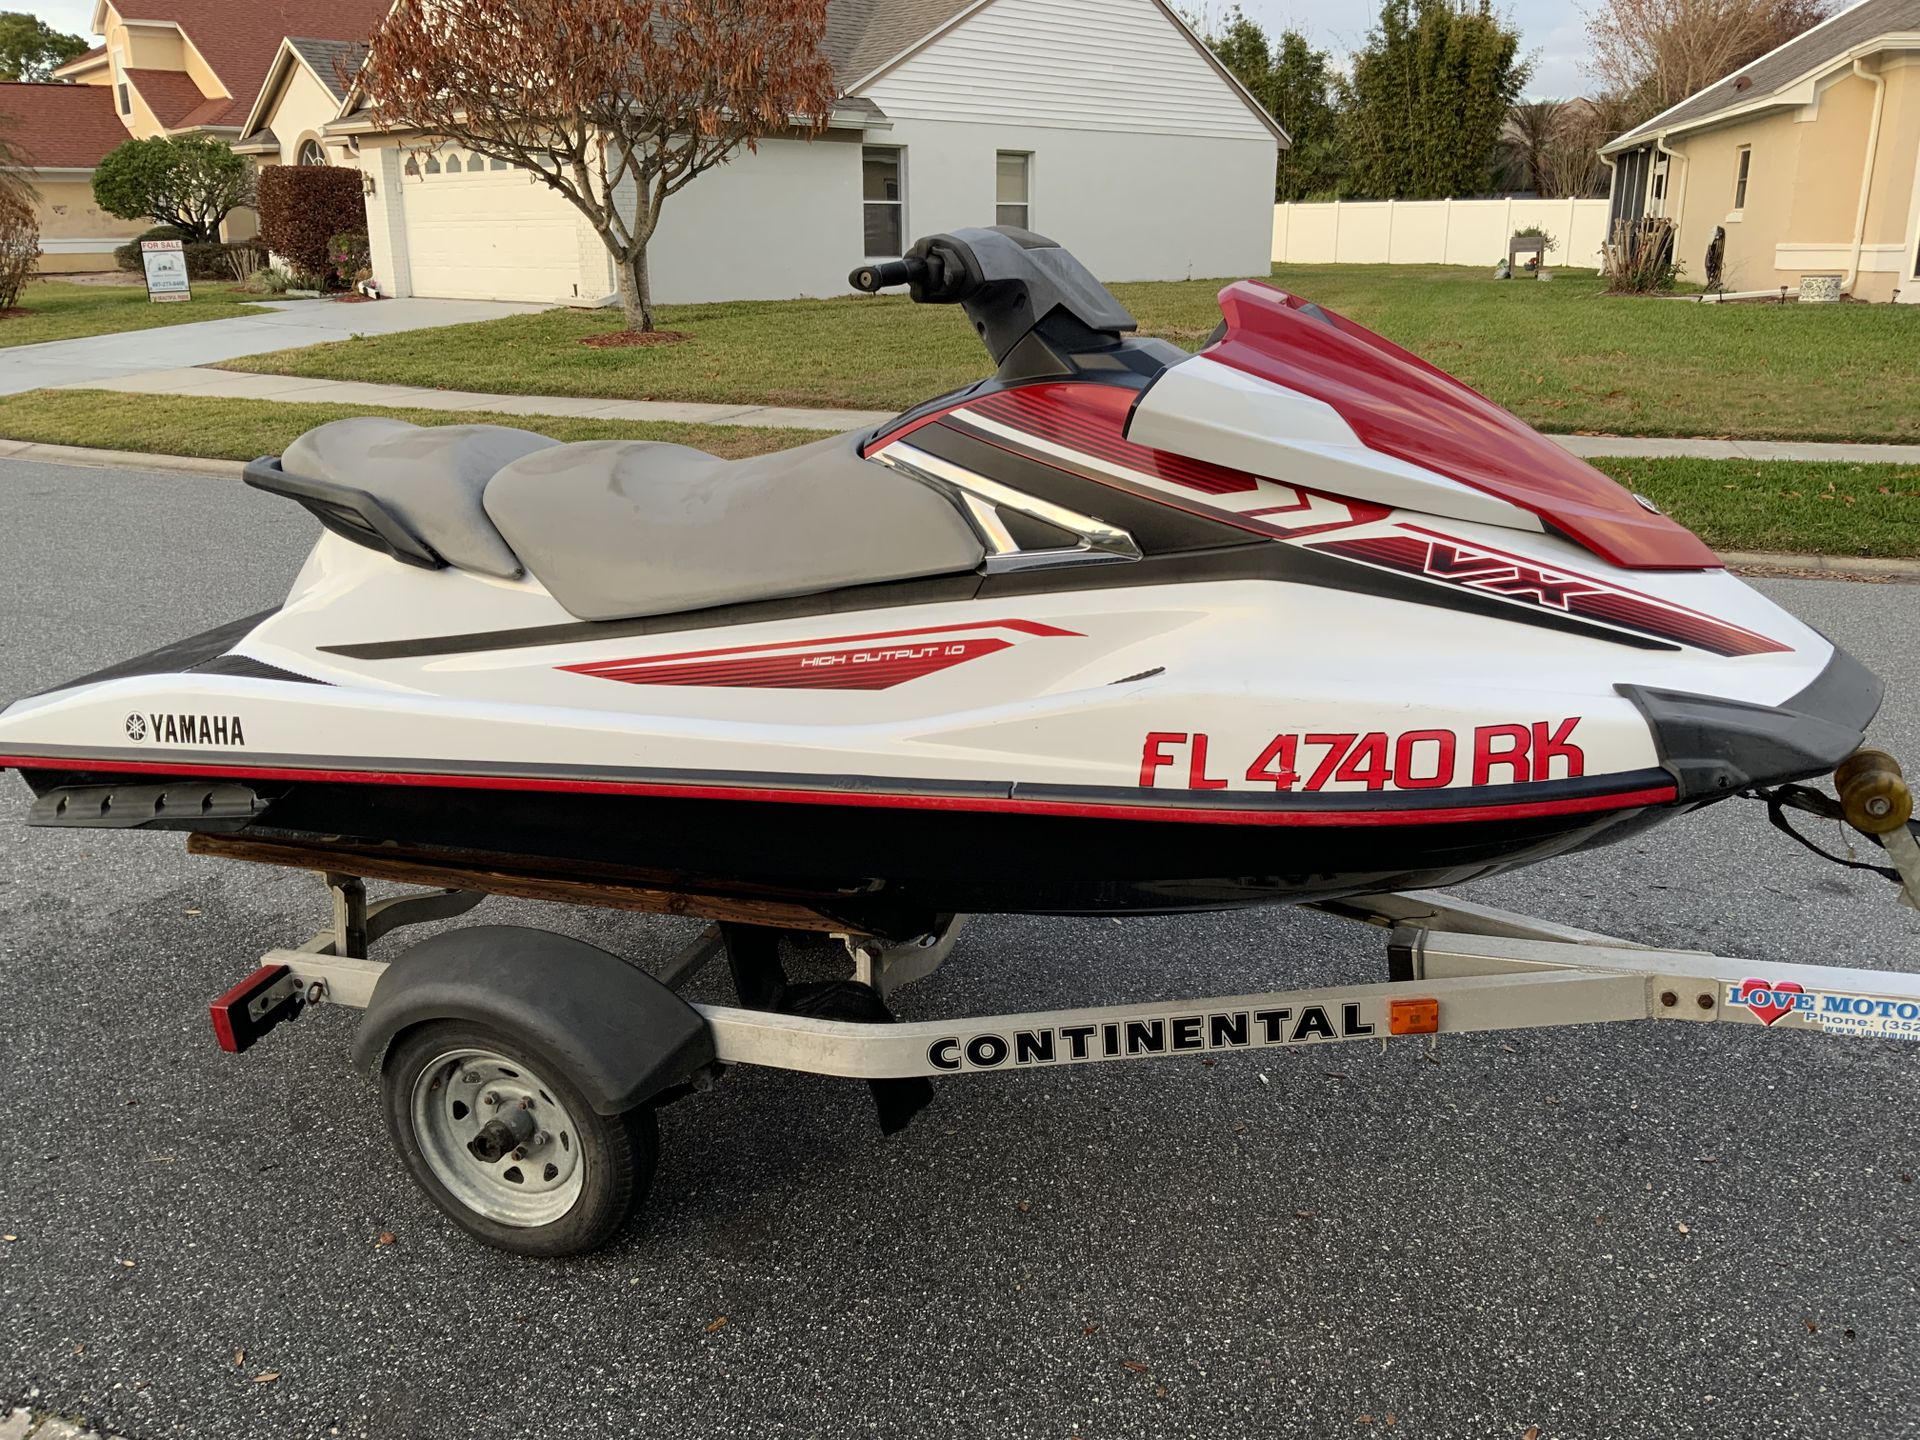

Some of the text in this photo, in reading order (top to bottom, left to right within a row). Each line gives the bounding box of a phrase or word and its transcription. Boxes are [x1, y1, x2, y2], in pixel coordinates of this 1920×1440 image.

[161, 241, 181, 249] SALE
[1423, 541, 1607, 611] VX
[801, 645, 965, 667] HIGH OUTPUT 1.0
[150, 714, 245, 746] YAMAHA
[1138, 716, 1585, 792] FL 4740 RK
[1729, 987, 1920, 1020] LOVE MOTO
[926, 1002, 1376, 1070] CONTINENTAL
[1805, 1012, 1874, 1028] Phone:
